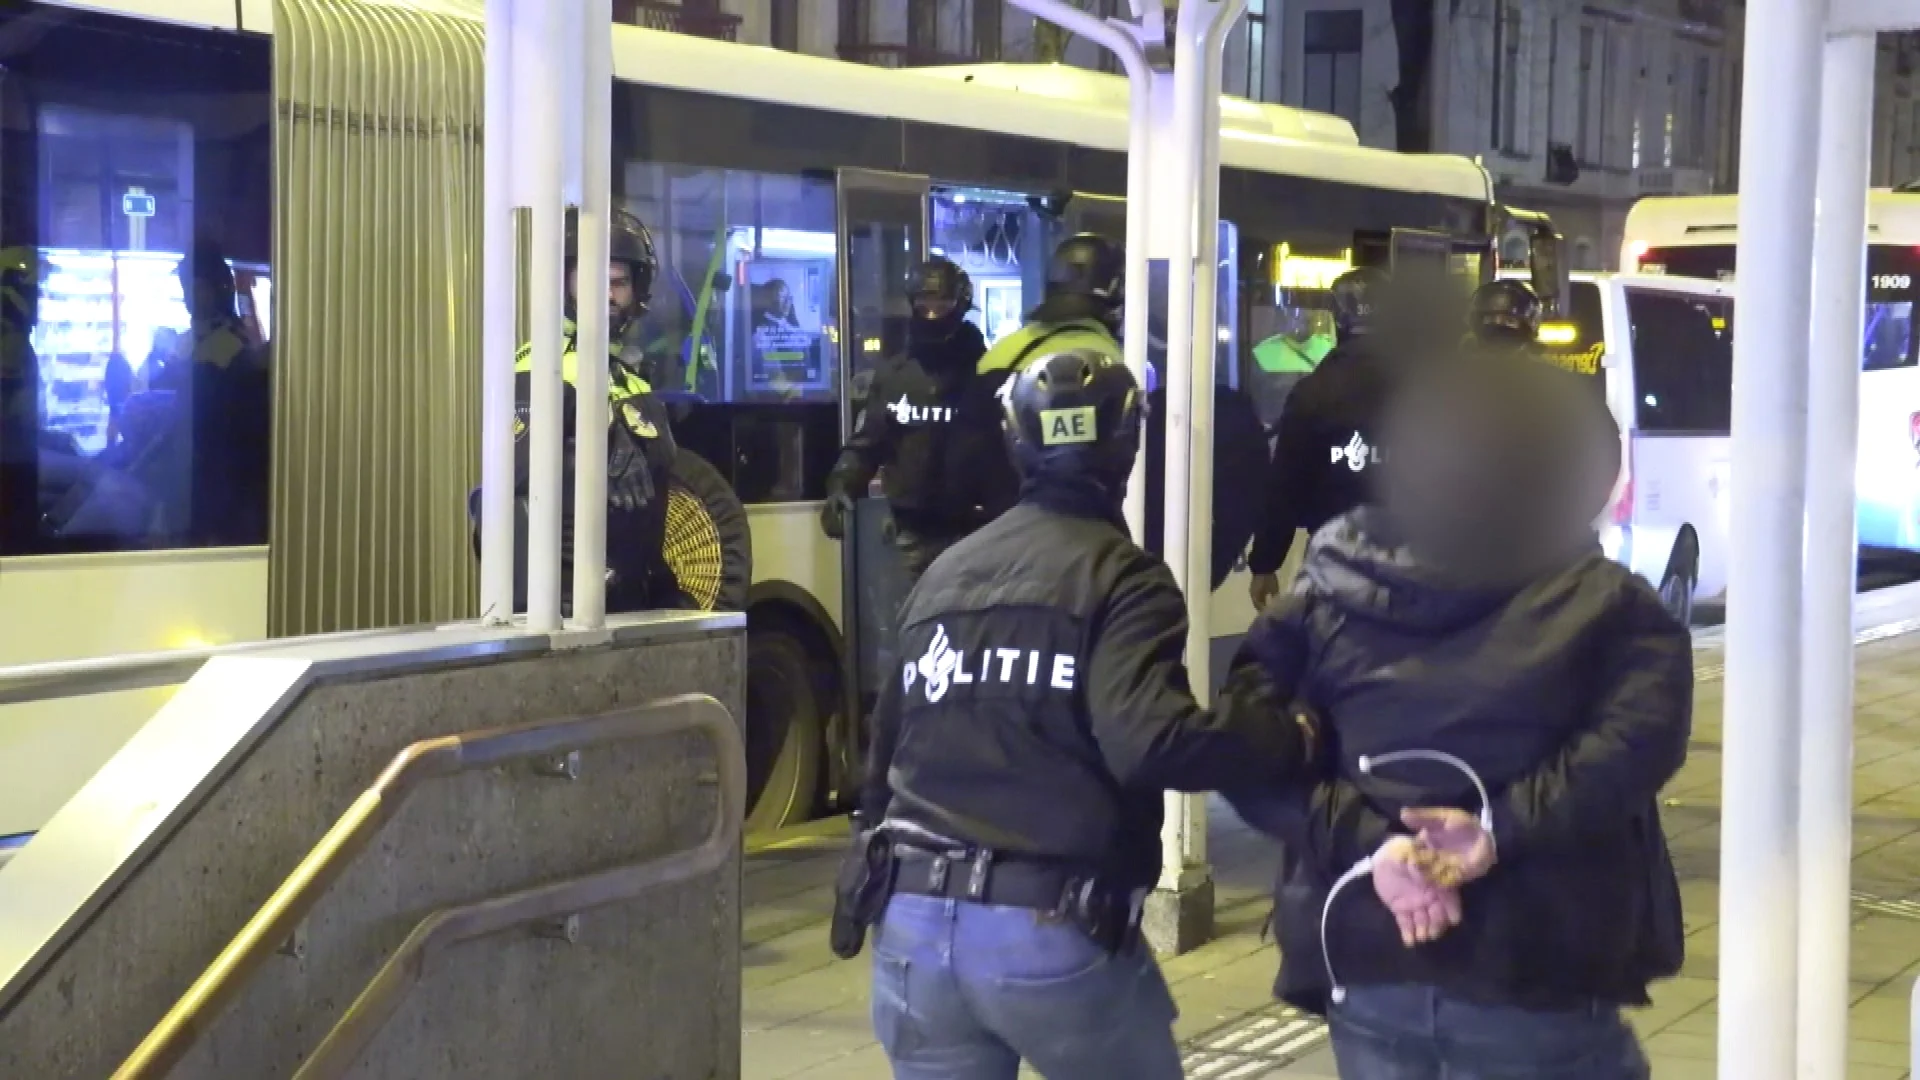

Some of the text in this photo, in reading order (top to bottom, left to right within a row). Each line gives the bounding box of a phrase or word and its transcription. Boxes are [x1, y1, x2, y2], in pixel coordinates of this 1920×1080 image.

[1871, 273, 1912, 290] 1909
[1051, 412, 1087, 439] AE
[902, 623, 1076, 704] POLITIE
